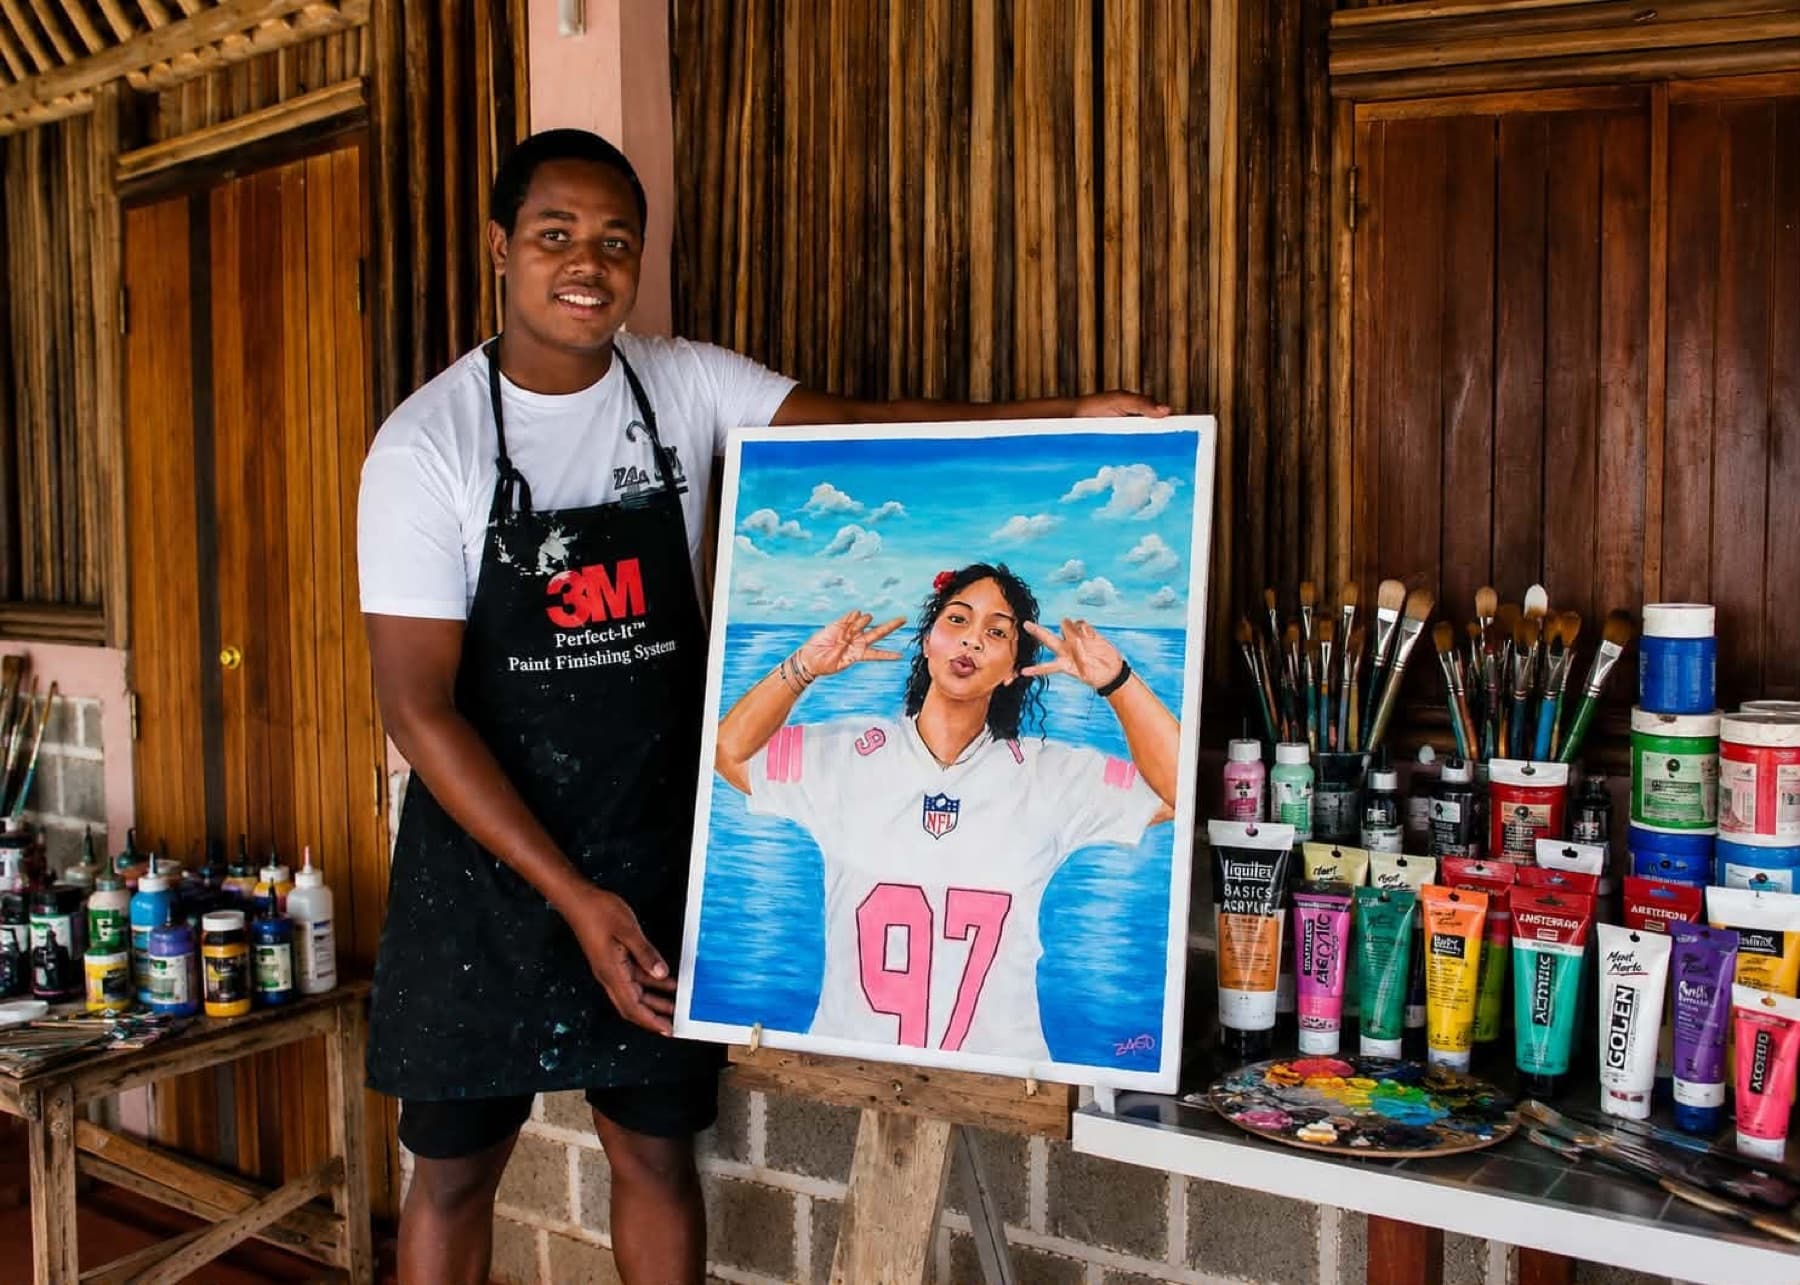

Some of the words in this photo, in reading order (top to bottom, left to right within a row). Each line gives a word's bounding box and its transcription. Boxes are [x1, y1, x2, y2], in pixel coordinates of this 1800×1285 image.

[546, 558, 646, 628] 3M
[508, 656, 551, 672] Paint
[556, 650, 632, 670] Finishing
[634, 639, 676, 661] System
[926, 812, 953, 835] NFL
[1223, 883, 1273, 899] BASICS
[1223, 899, 1273, 915] ACRYLIC
[855, 883, 1013, 1051] 97
[1608, 987, 1633, 1068] GOLEN
